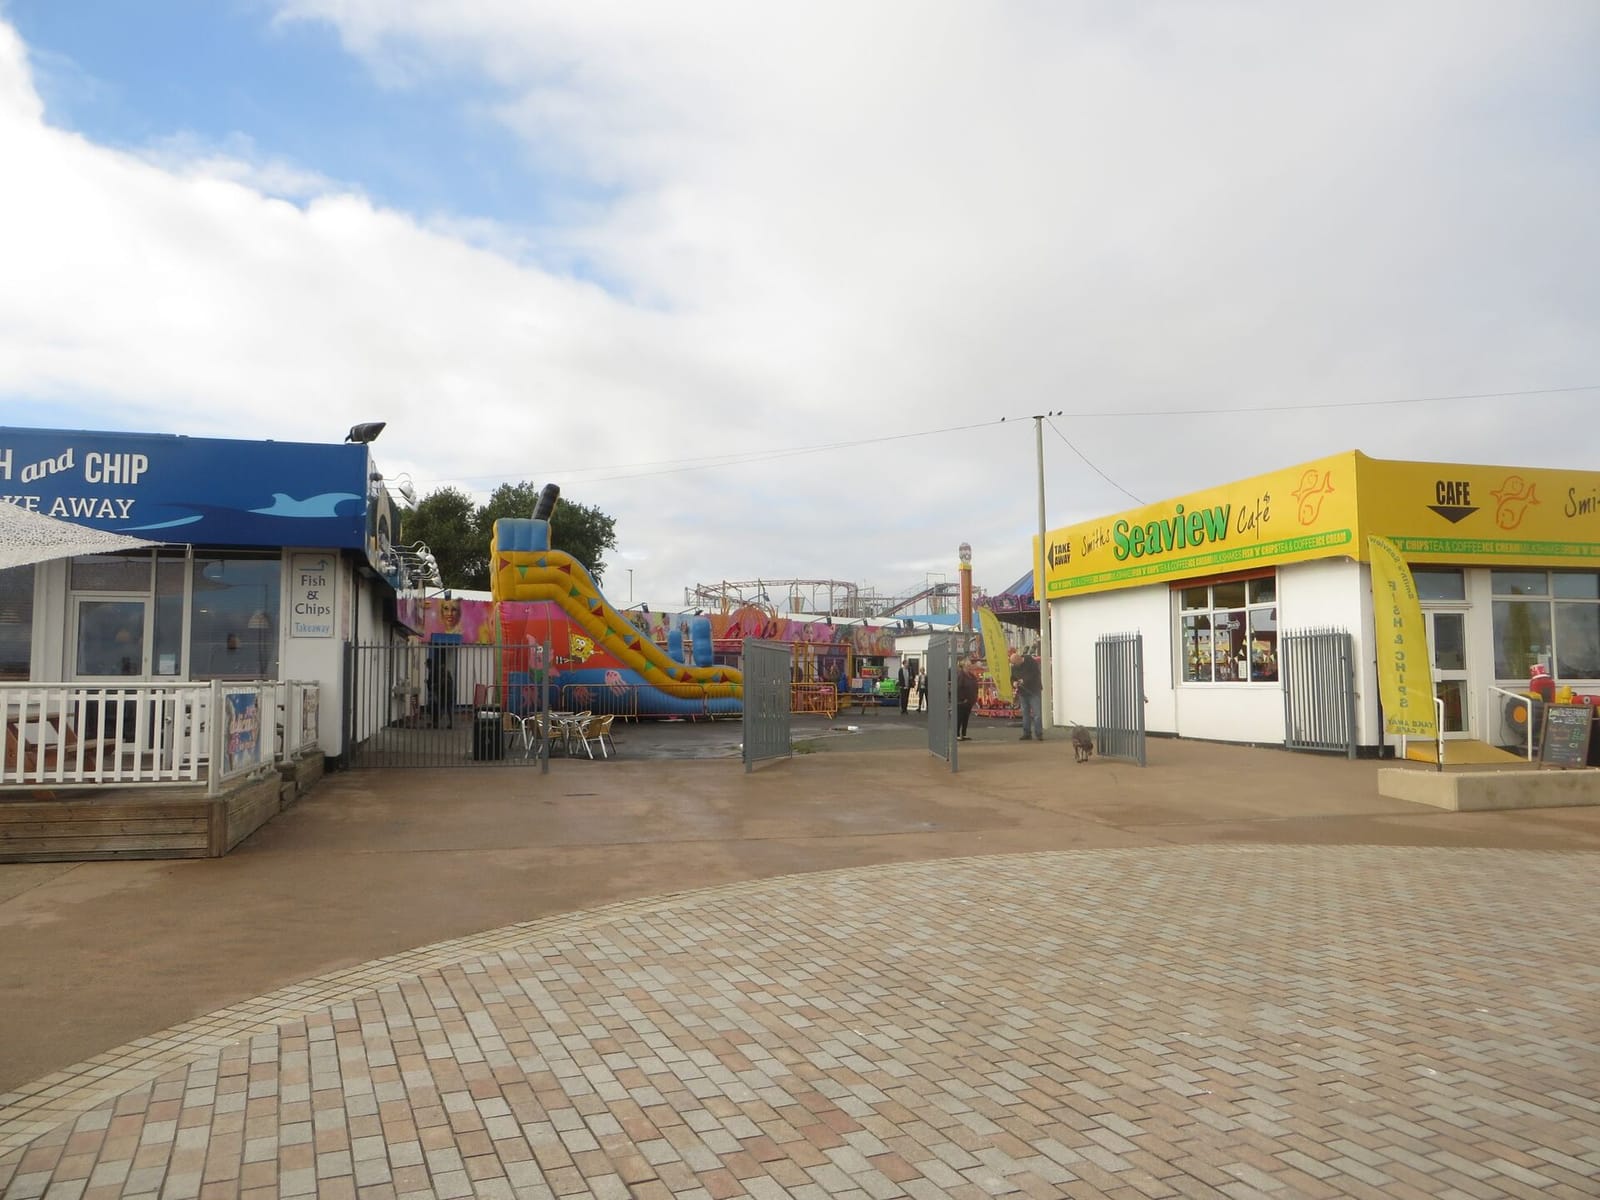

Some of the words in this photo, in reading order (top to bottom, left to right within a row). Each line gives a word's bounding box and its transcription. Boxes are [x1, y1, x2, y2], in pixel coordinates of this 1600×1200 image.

[21, 448, 75, 483] and
[85, 453, 148, 484] CHIP
[1435, 480, 1471, 506] CAFE
[48, 497, 135, 518] AWAY
[1113, 504, 1231, 561] Seaview
[1054, 542, 1071, 554] TAKE
[1294, 538, 1317, 550] COFFEE
[1429, 540, 1445, 552] TEA
[1451, 541, 1483, 553] COFFEE
[1054, 553, 1071, 566] AWAY
[300, 575, 326, 587] Fish
[306, 590, 319, 600] &
[295, 603, 330, 616] Chips
[295, 622, 330, 633] Takeaway
